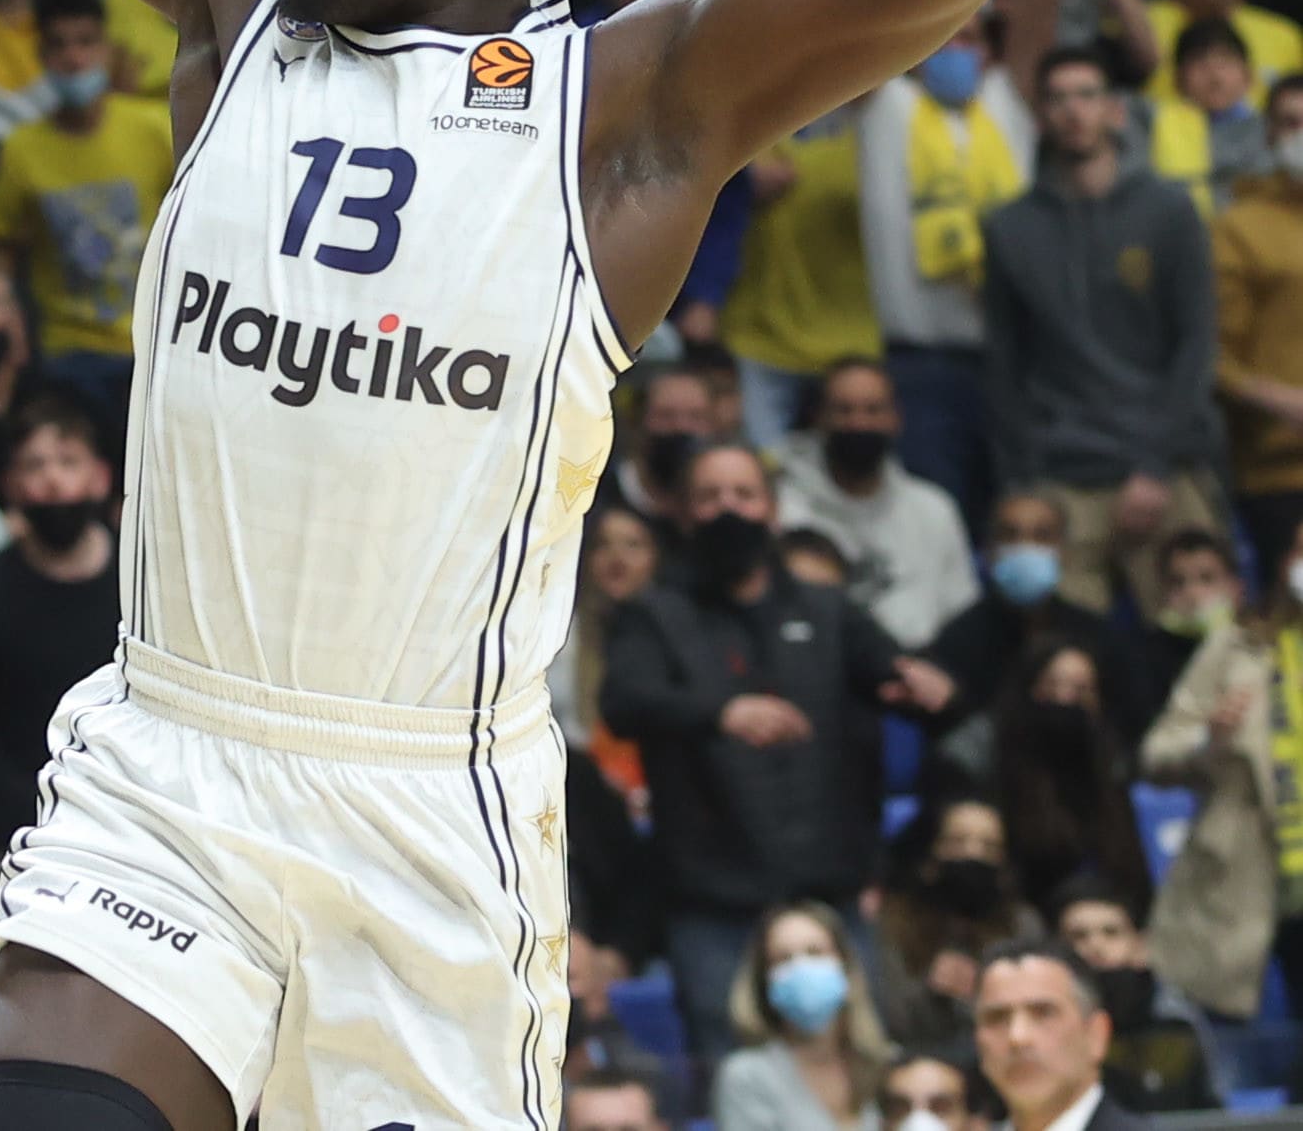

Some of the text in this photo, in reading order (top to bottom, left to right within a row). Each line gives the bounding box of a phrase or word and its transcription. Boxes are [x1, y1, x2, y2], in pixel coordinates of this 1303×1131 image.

[470, 95, 526, 103] AIRLINES
[471, 87, 527, 96] TURKISH
[280, 136, 418, 275] 13
[171, 270, 511, 412] Playtika
[89, 887, 199, 954] Rapyd
